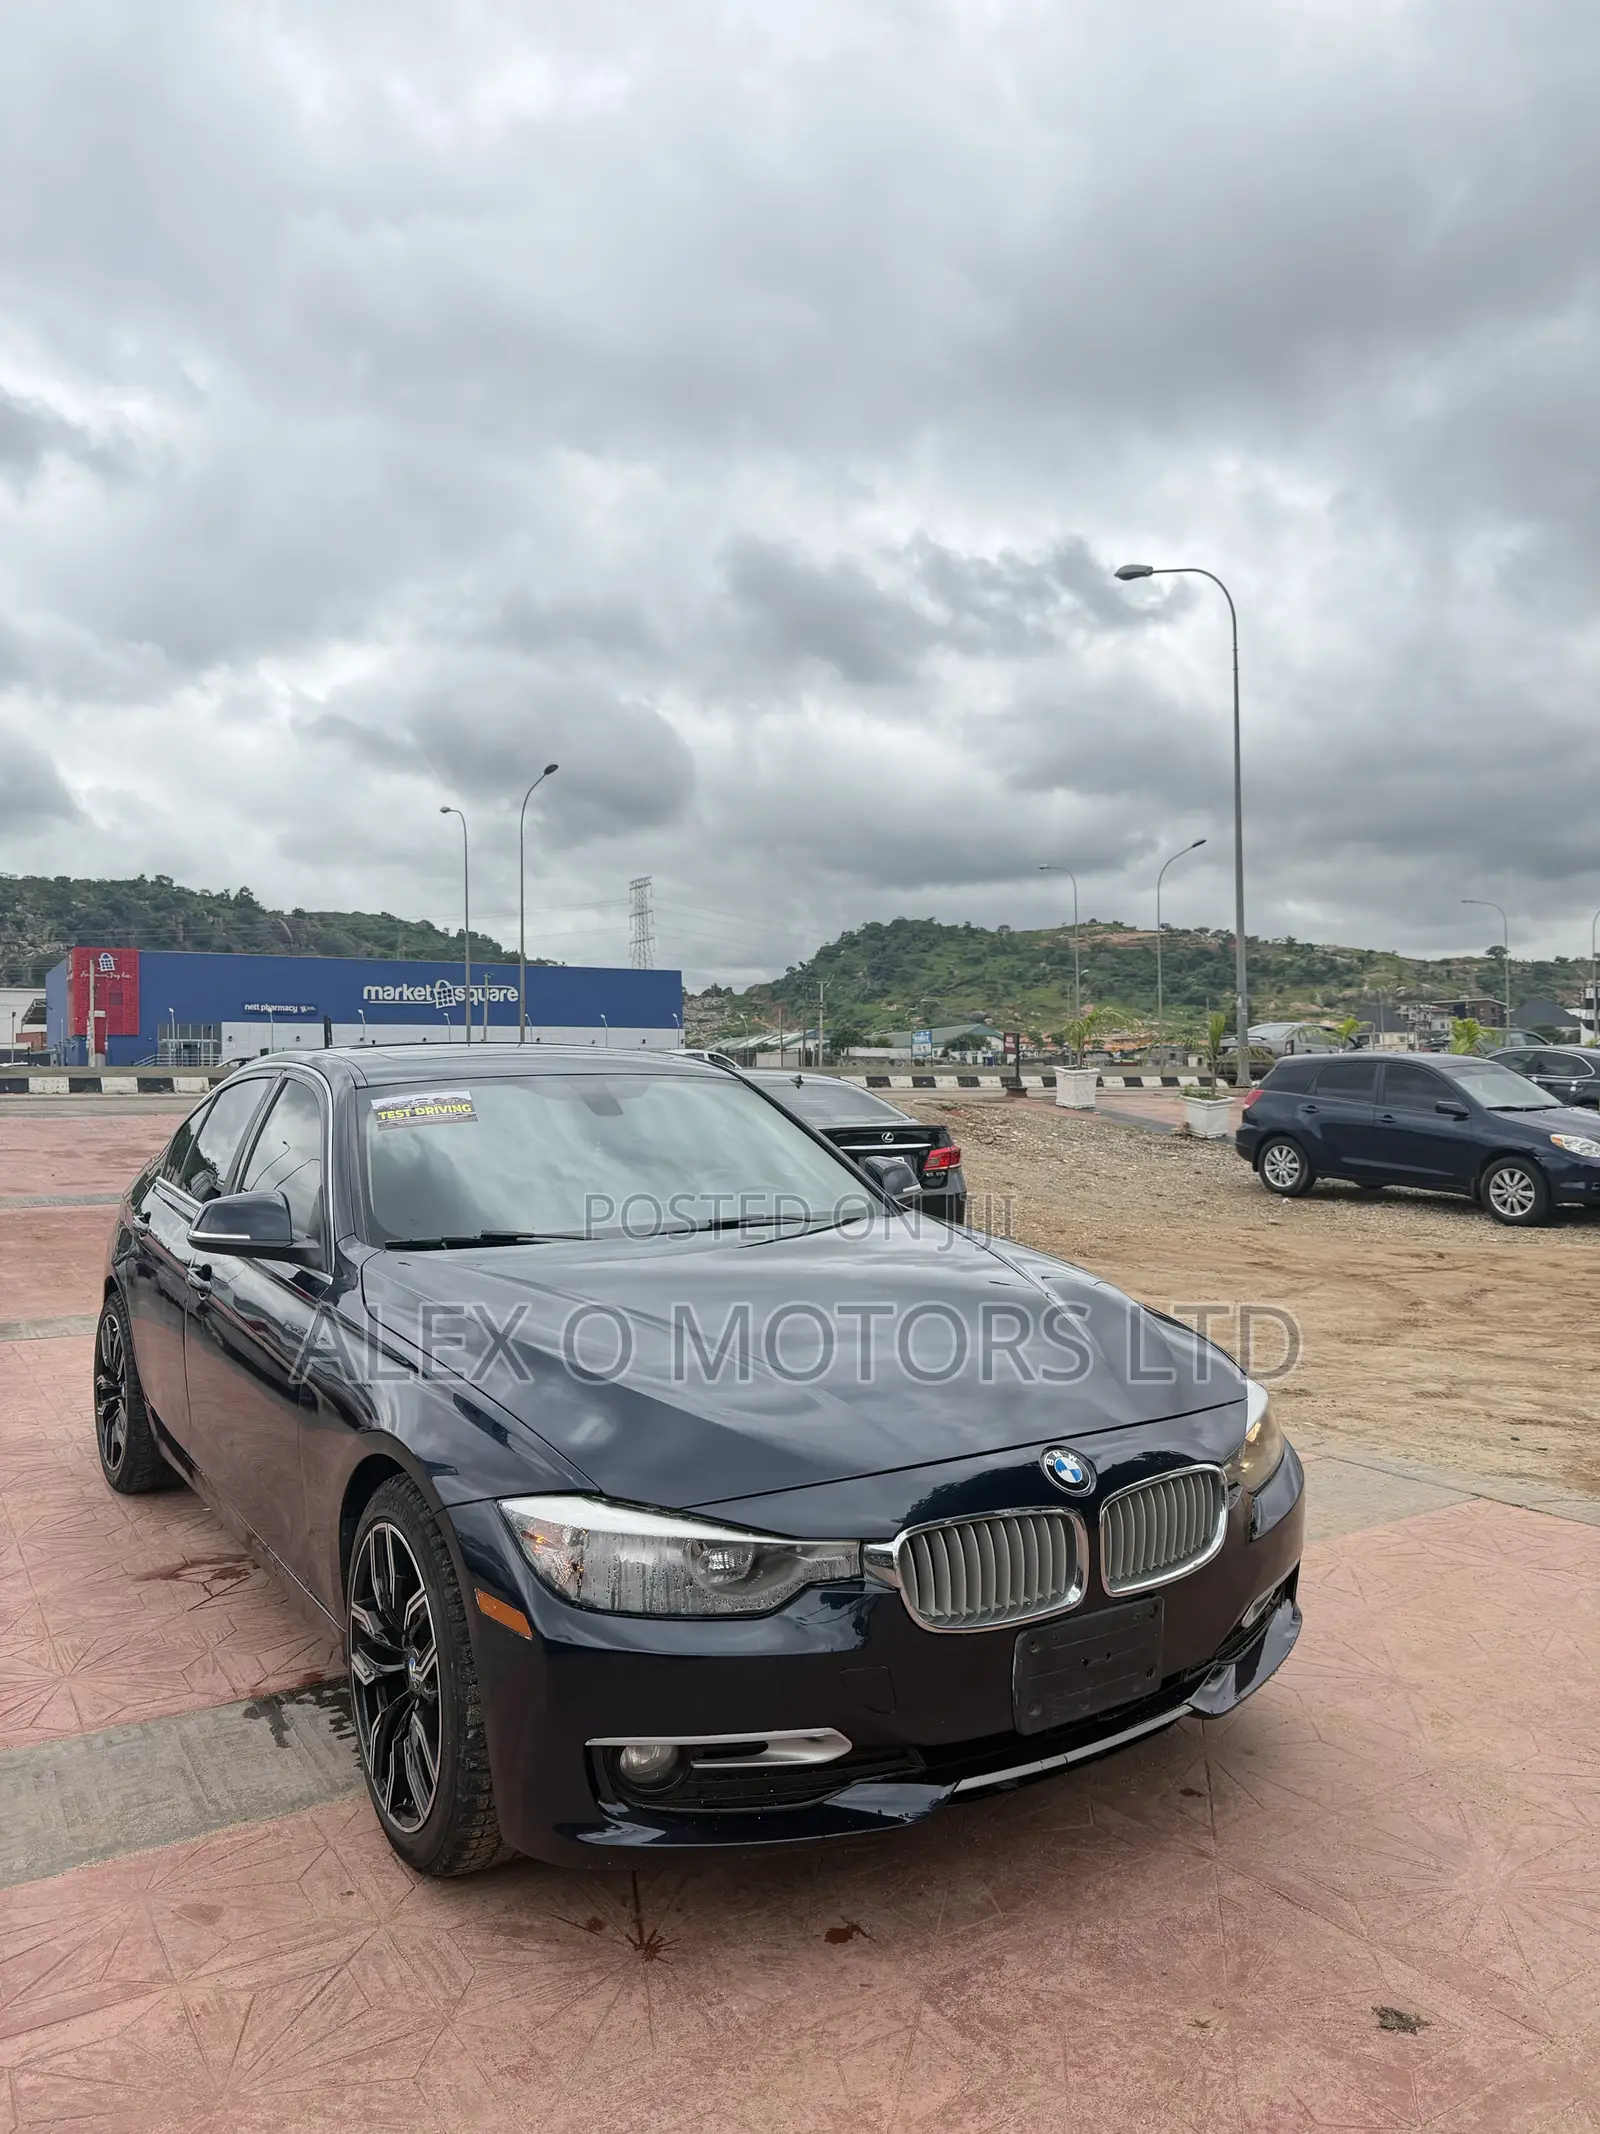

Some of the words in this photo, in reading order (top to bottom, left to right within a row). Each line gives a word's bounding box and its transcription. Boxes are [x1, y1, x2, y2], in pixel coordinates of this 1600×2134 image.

[363, 984, 433, 1001] market
[454, 987, 519, 1006] square
[260, 1003, 298, 1014] pharmacy
[378, 1108, 412, 1120] TEST
[413, 1103, 472, 1116] DRIVING
